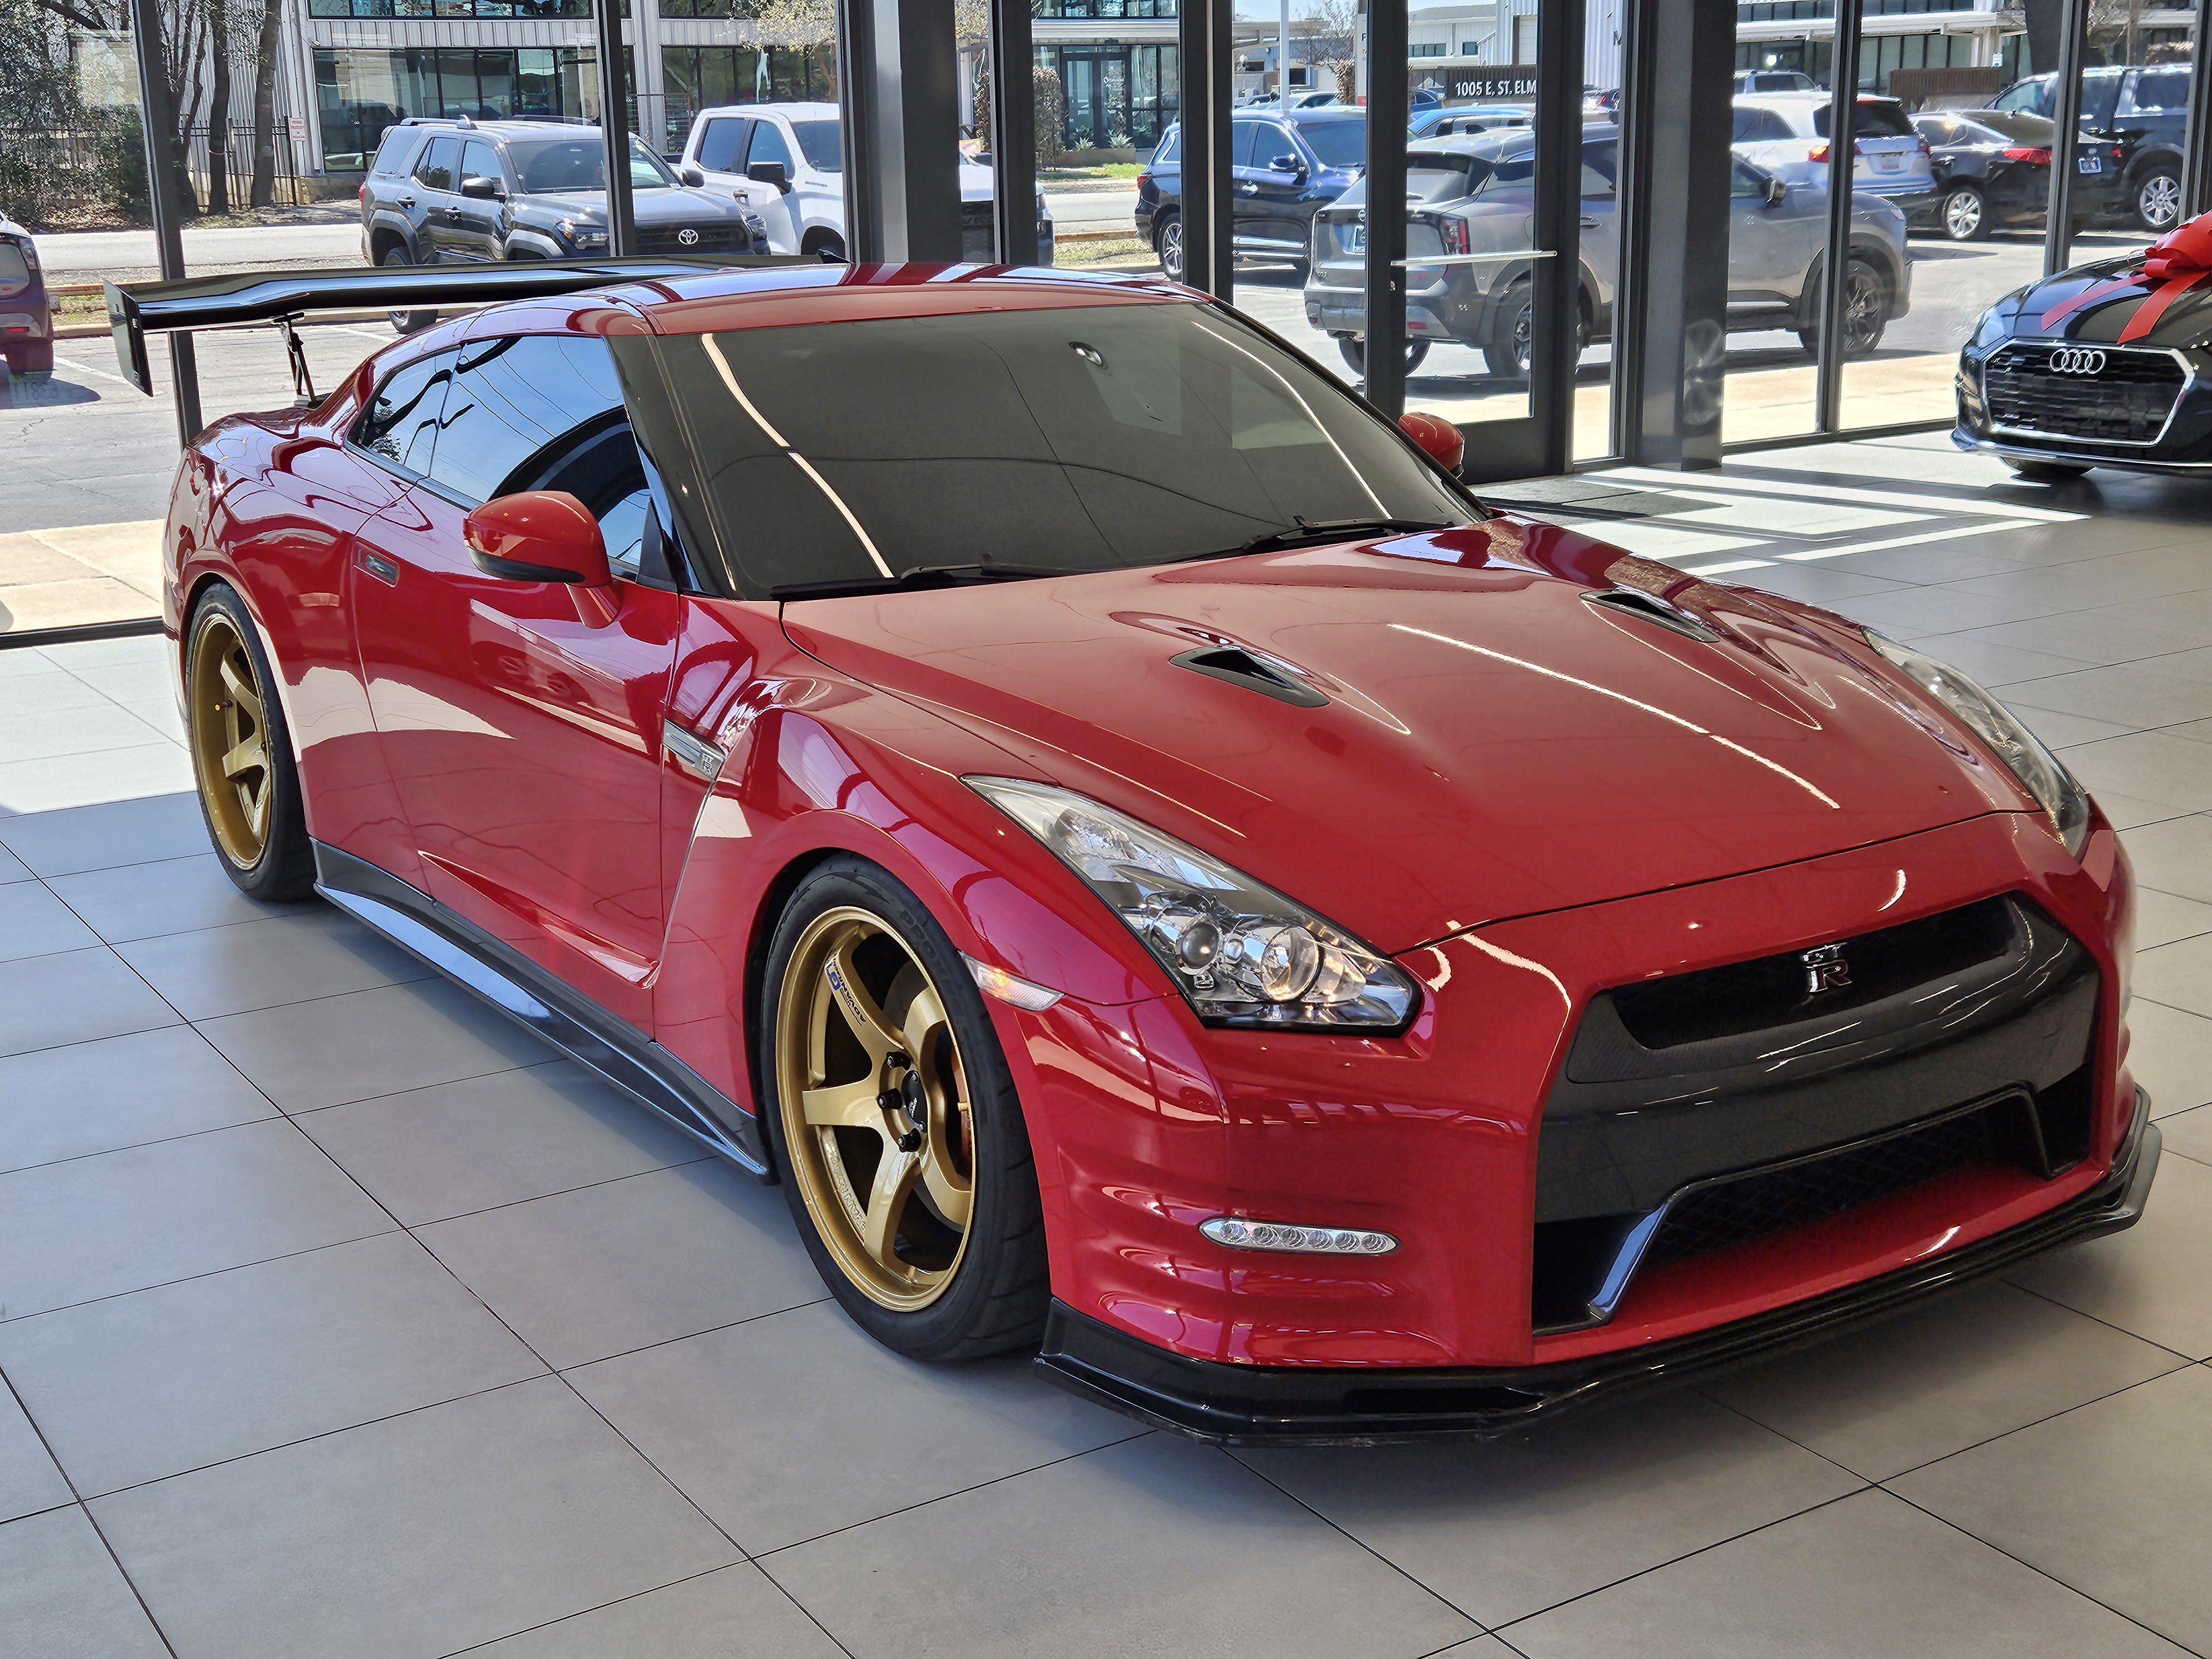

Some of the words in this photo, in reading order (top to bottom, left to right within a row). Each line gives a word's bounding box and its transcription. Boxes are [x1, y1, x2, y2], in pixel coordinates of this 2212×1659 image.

[1455, 81, 1483, 97] 1005
[1498, 80, 1512, 95] ST.
[1806, 959, 1853, 993] R
